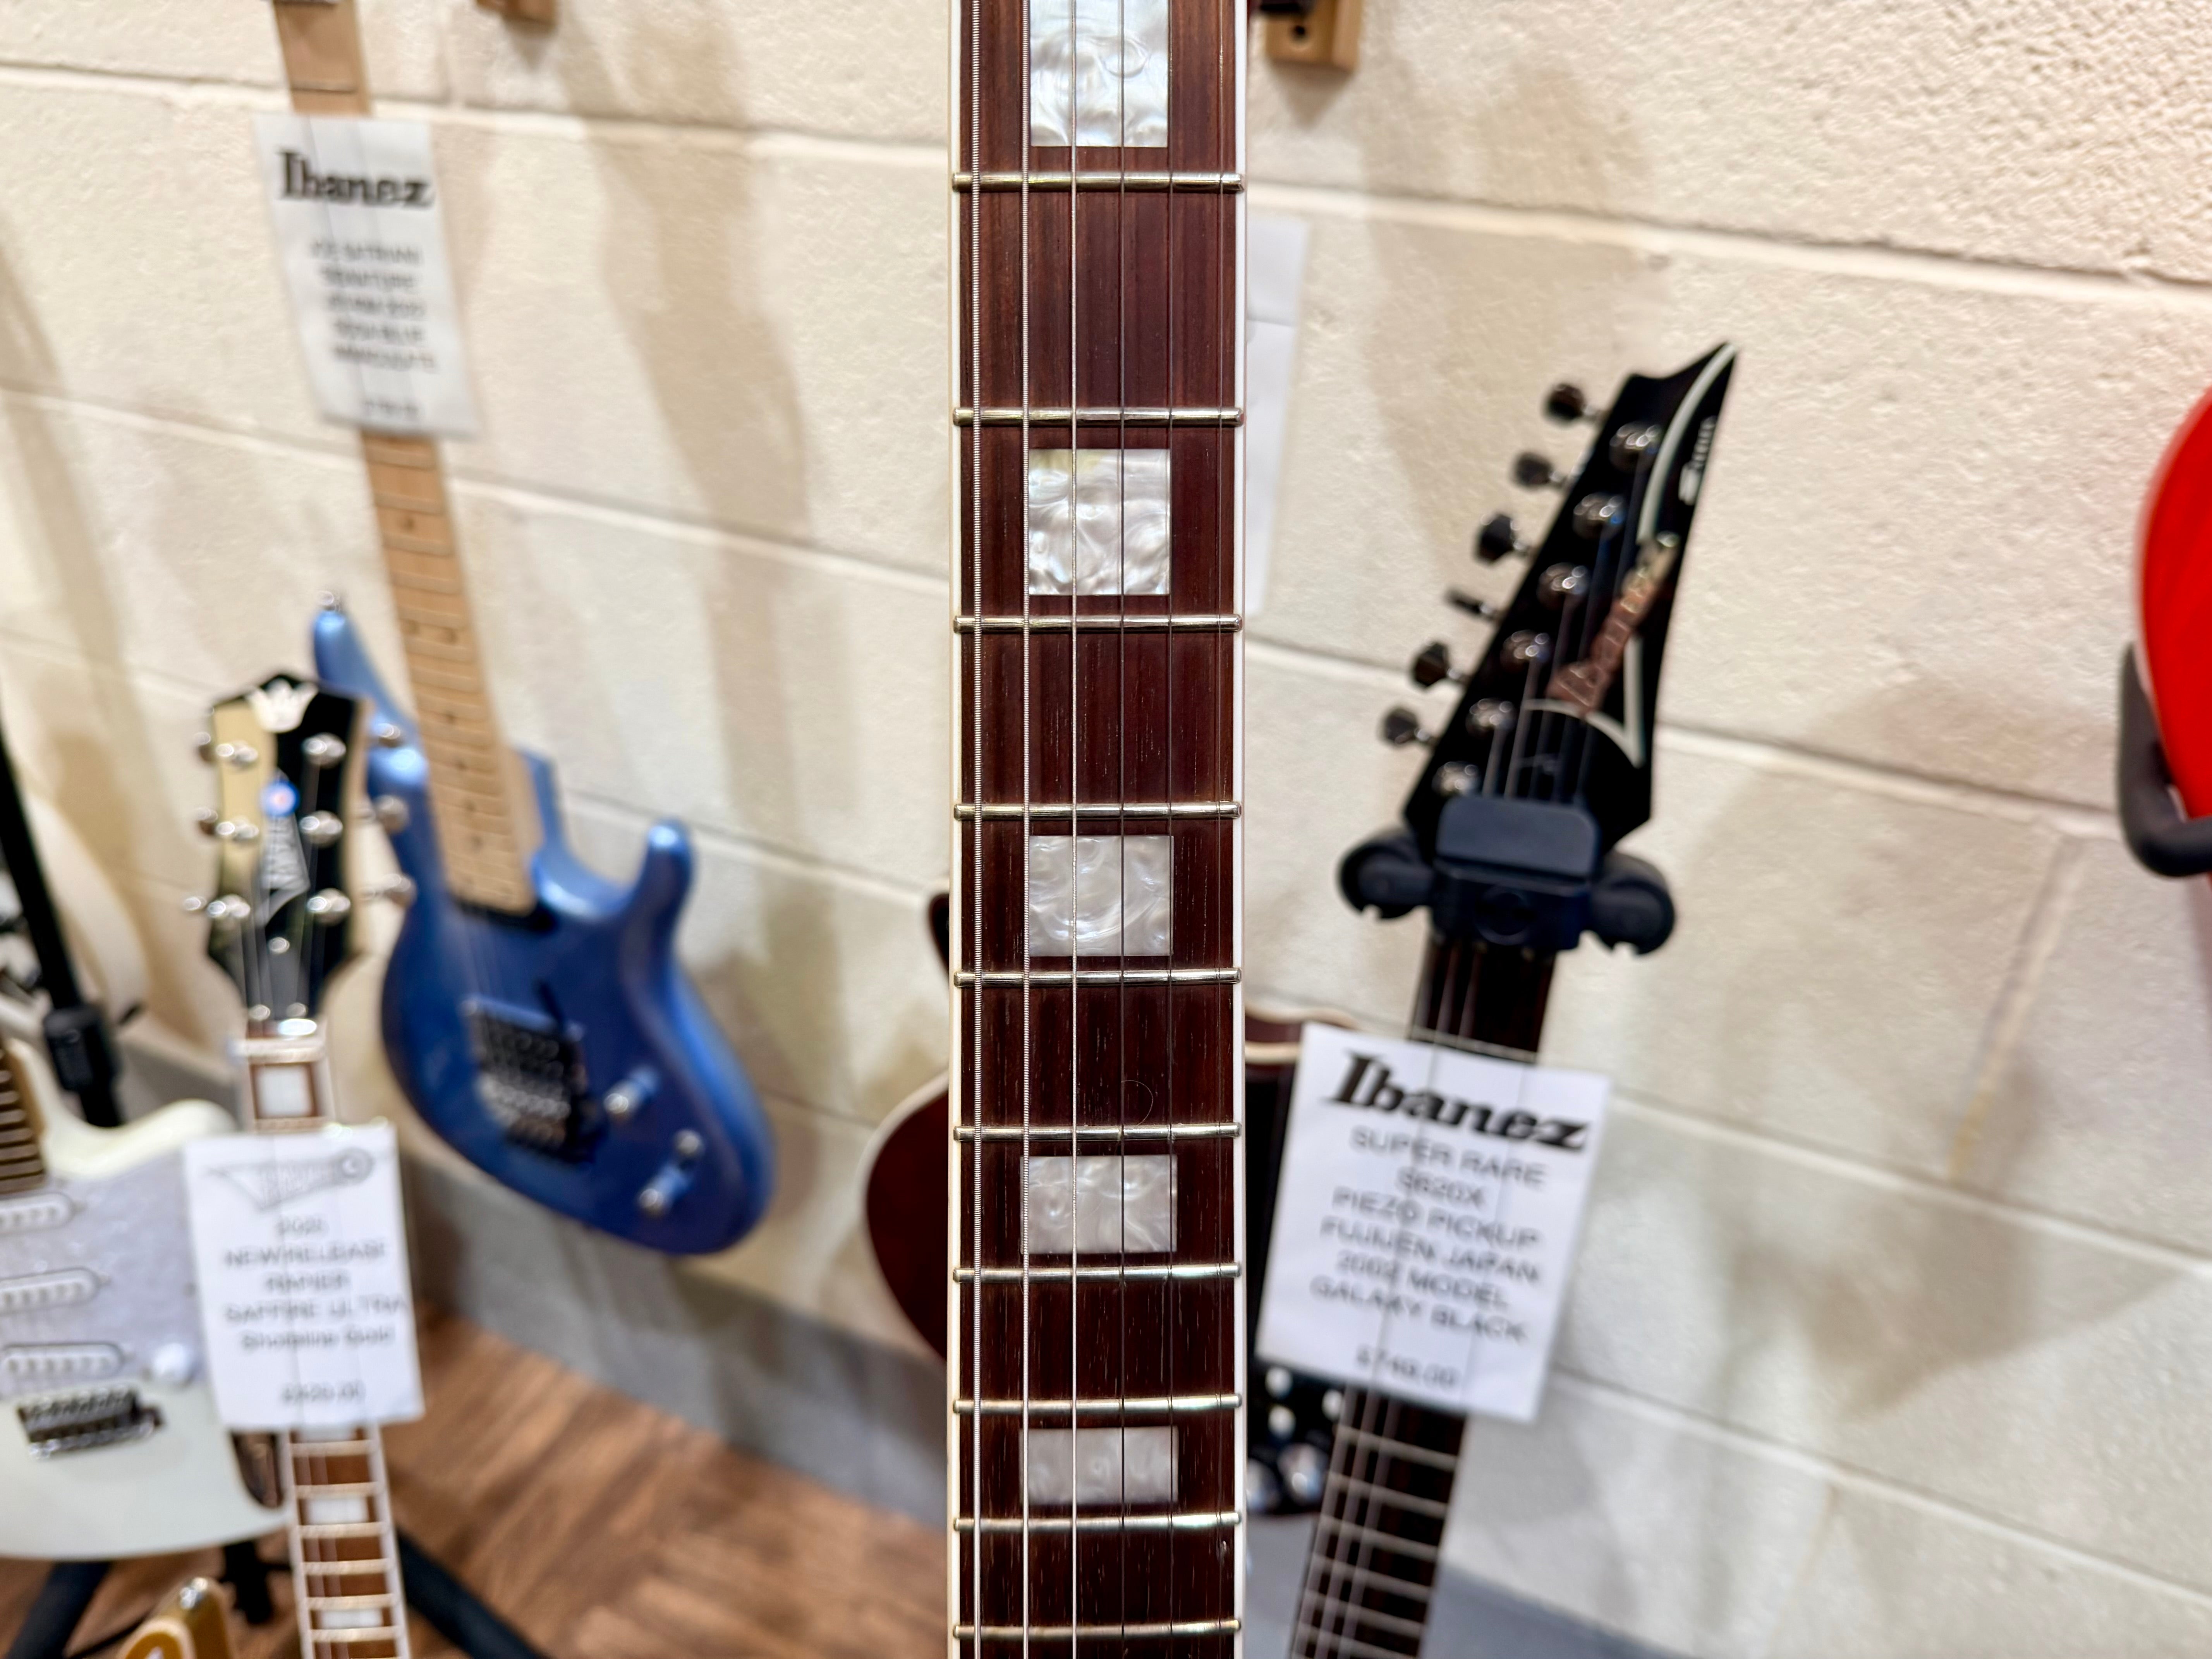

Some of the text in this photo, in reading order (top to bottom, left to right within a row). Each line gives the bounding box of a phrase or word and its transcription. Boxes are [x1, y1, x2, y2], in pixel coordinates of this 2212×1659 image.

[277, 150, 434, 209] Ibanez
[1323, 1050, 1588, 1151] Ibanez
[1352, 1127, 1547, 1185] SUPER RARE
[1334, 1188, 1540, 1246] PIEZO PICKUP
[1409, 1270, 1507, 1308] MODEL
[1445, 1245, 1538, 1283] JAPAN
[1312, 1277, 1523, 1342] GALAXY BLACK
